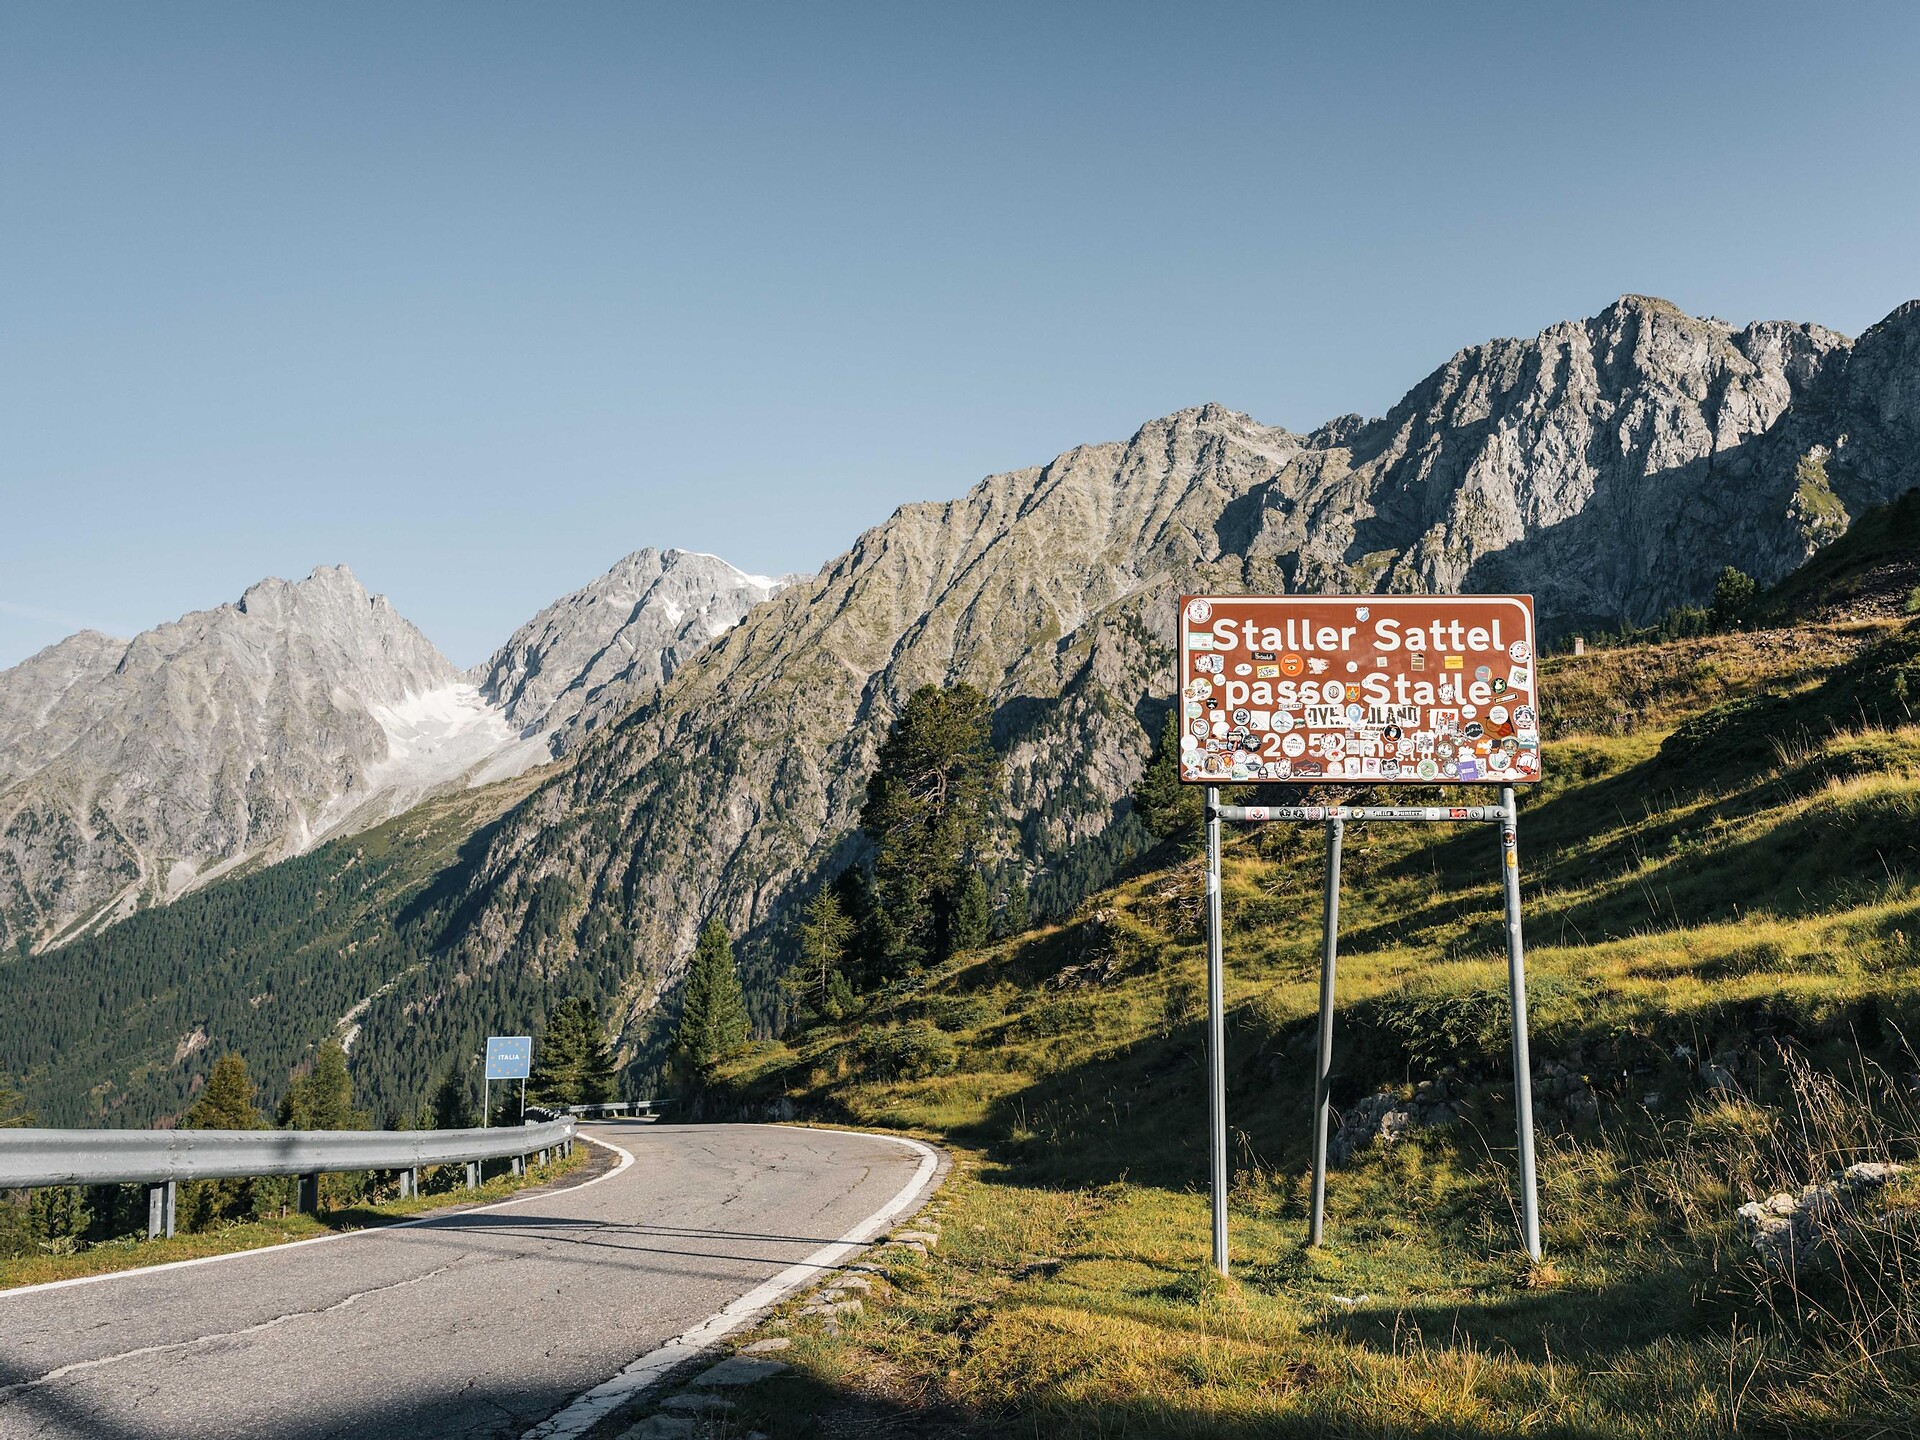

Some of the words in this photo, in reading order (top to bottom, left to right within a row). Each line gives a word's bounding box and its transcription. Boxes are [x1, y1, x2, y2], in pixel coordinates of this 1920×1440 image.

[1213, 618, 1356, 651] Staller
[1373, 619, 1505, 651] Sattel
[1226, 680, 1345, 710] passo
[1362, 672, 1492, 705] Stalle
